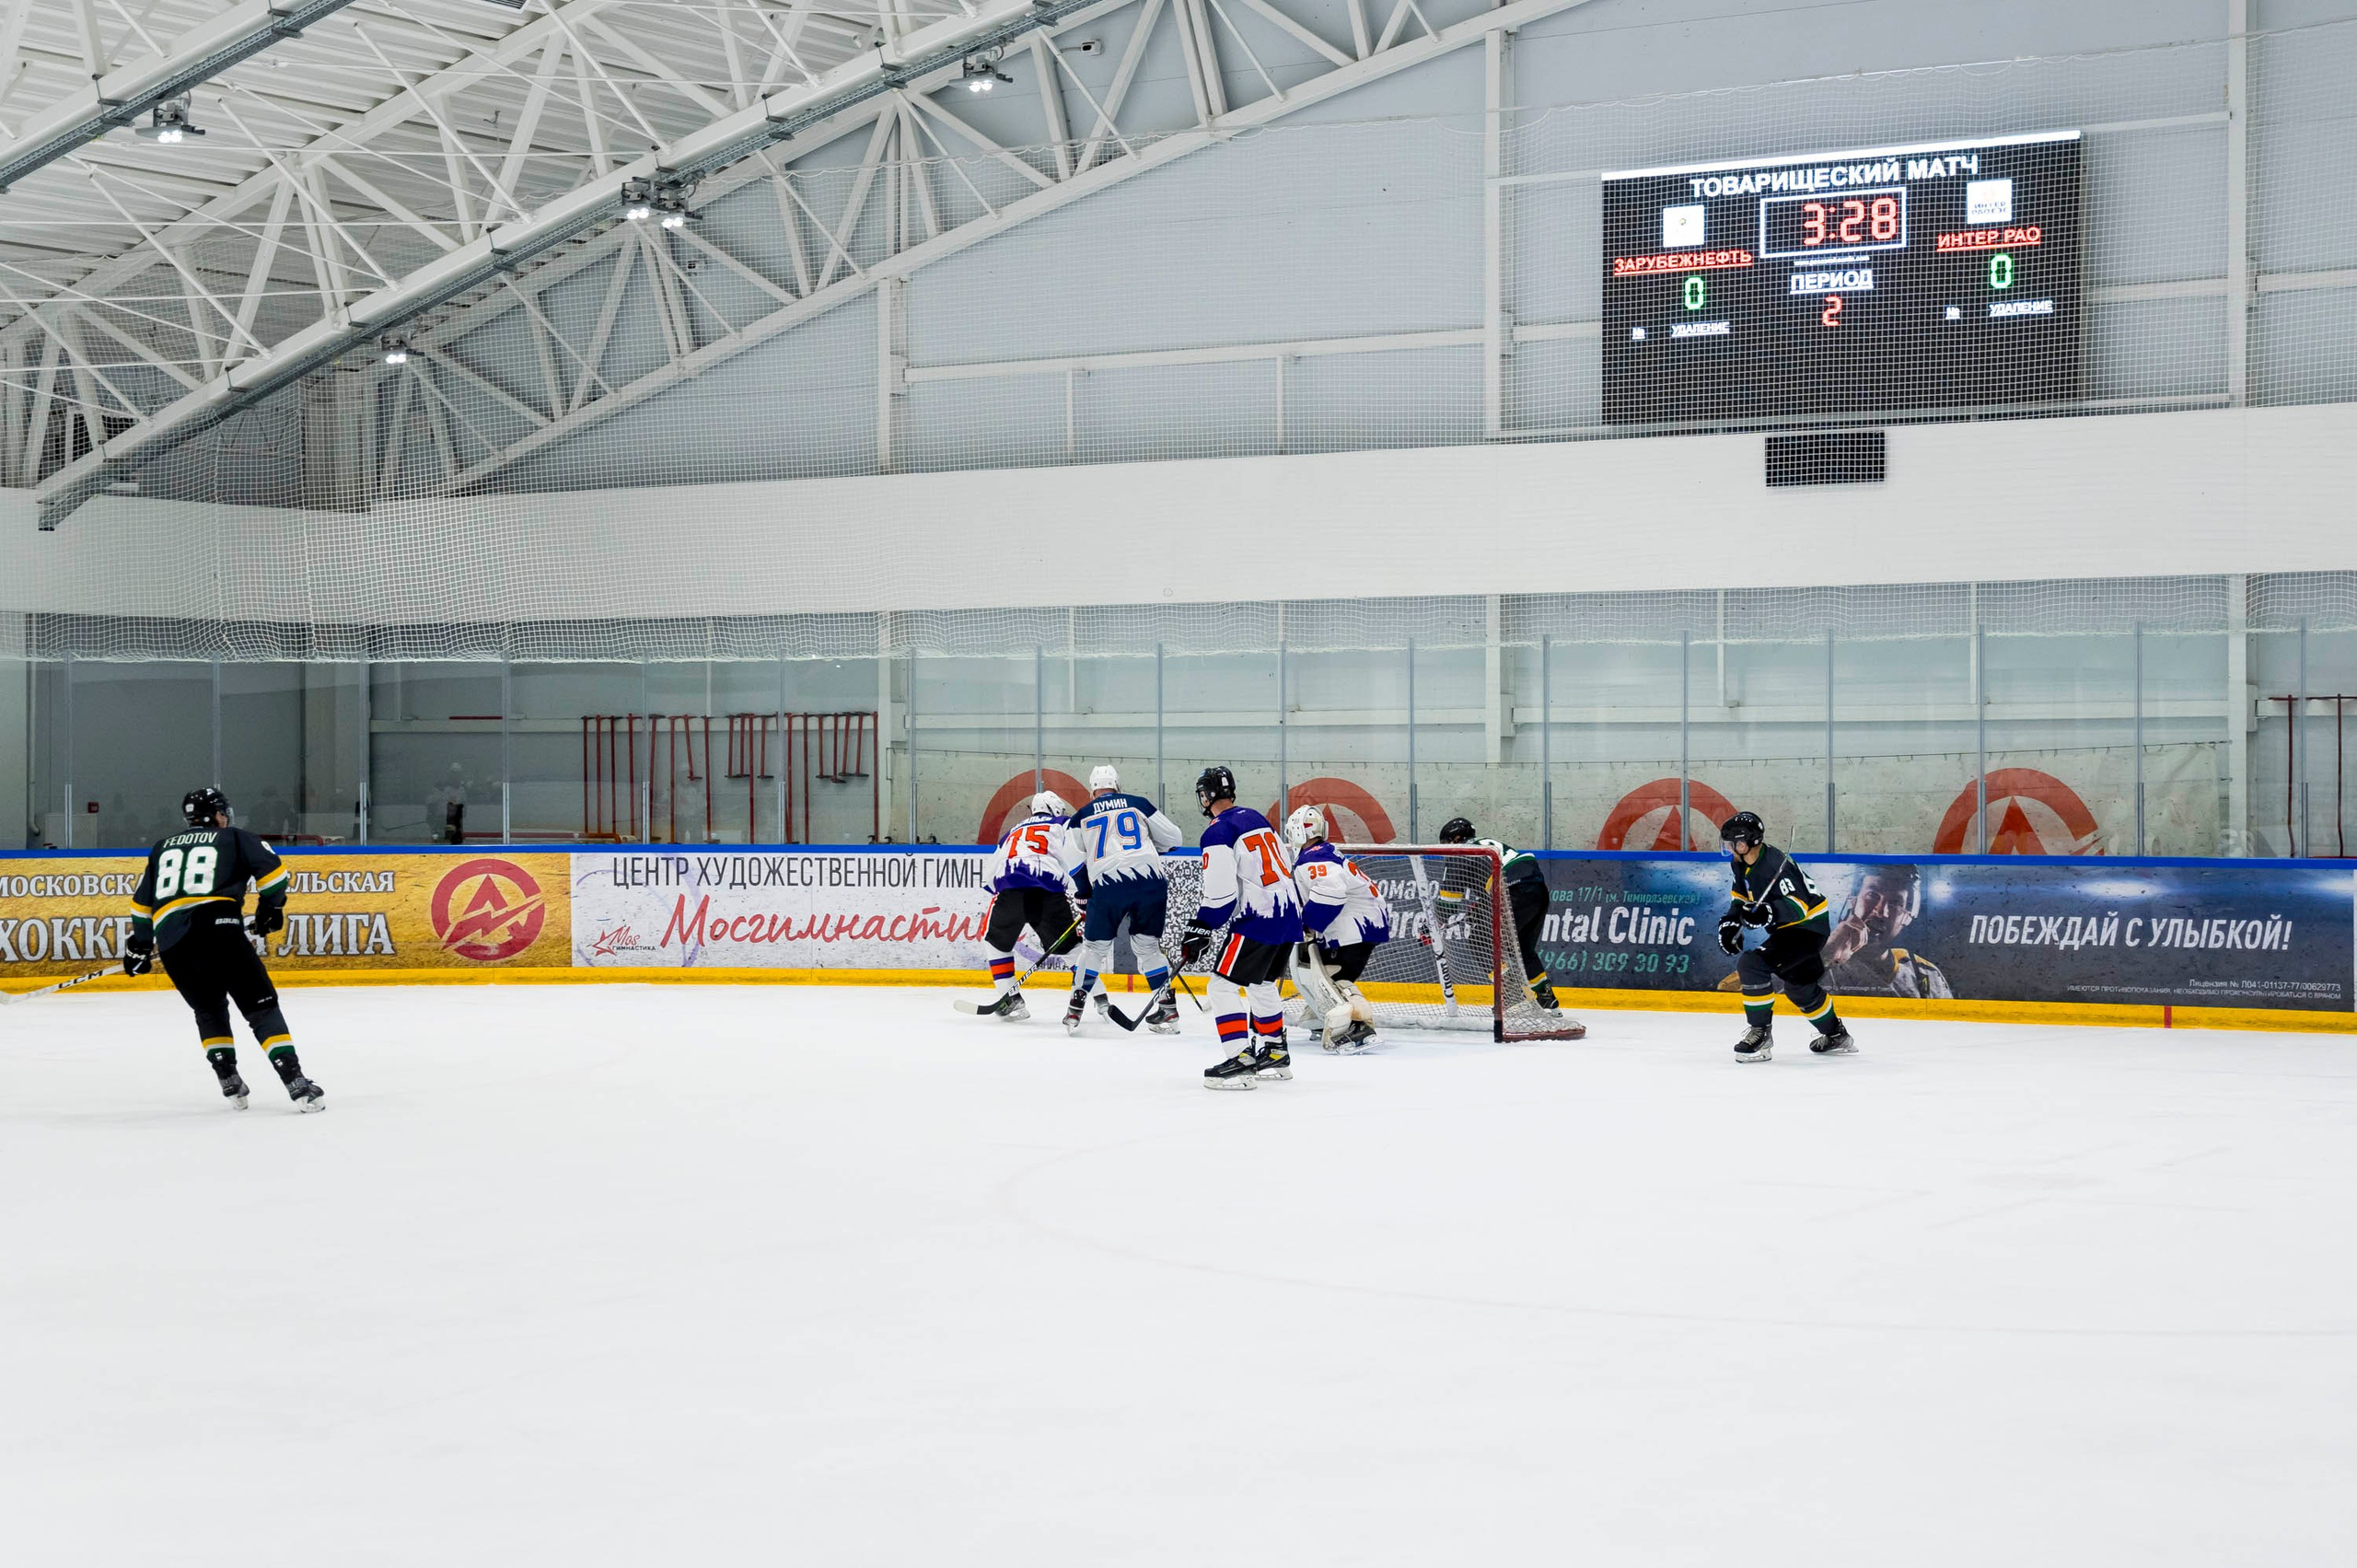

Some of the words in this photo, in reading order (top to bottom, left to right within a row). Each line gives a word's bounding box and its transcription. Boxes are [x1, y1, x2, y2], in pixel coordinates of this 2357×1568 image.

[1689, 157, 1899, 198] ТОВАРИЩЕСКИЙ
[1907, 155, 1979, 180] МАТЧ
[1803, 197, 1897, 246] 3:28
[1937, 230, 1999, 249] ИНТЕР
[2003, 226, 2041, 244] РАО
[1614, 250, 1753, 274] ЗАРУБЕЖНЕФТЬ
[1990, 254, 2014, 289] 0
[1685, 276, 1704, 310] 0
[1790, 269, 1874, 292] ПЕРИОД
[1822, 295, 1841, 326] 2
[1990, 300, 2054, 317] УДАЛЕНИЕ
[1671, 322, 1730, 337] УДАЛЕНИЕ
[1093, 798, 1128, 815] ДУМИН
[163, 831, 218, 849] FEDOTOV
[1005, 824, 1051, 860] 75
[1082, 808, 1143, 862] 79
[155, 845, 218, 900] 88
[613, 857, 689, 889] ЦЕНТР
[696, 853, 916, 889] ХУДОЖЕСТВЕННОЙ
[923, 858, 984, 889] ГИМН
[1243, 831, 1293, 887] 70
[1307, 864, 1328, 880] 39
[1577, 886, 1604, 903] 17/1
[1779, 877, 1796, 897] 83
[278, 913, 396, 958] ЛИГА
[1541, 906, 1602, 944] ntal
[1608, 906, 1696, 946] Clinic
[1969, 912, 2119, 950] ПОБЕЖДАЙ
[2124, 917, 2143, 947] С
[2147, 913, 2293, 950] УЛЫБКОЙ!
[1592, 951, 1629, 972] 309
[1633, 952, 1660, 973] 30
[1665, 954, 1689, 974] 93
[58, 970, 103, 990] CCM
[2189, 979, 2227, 988] Лицензия
